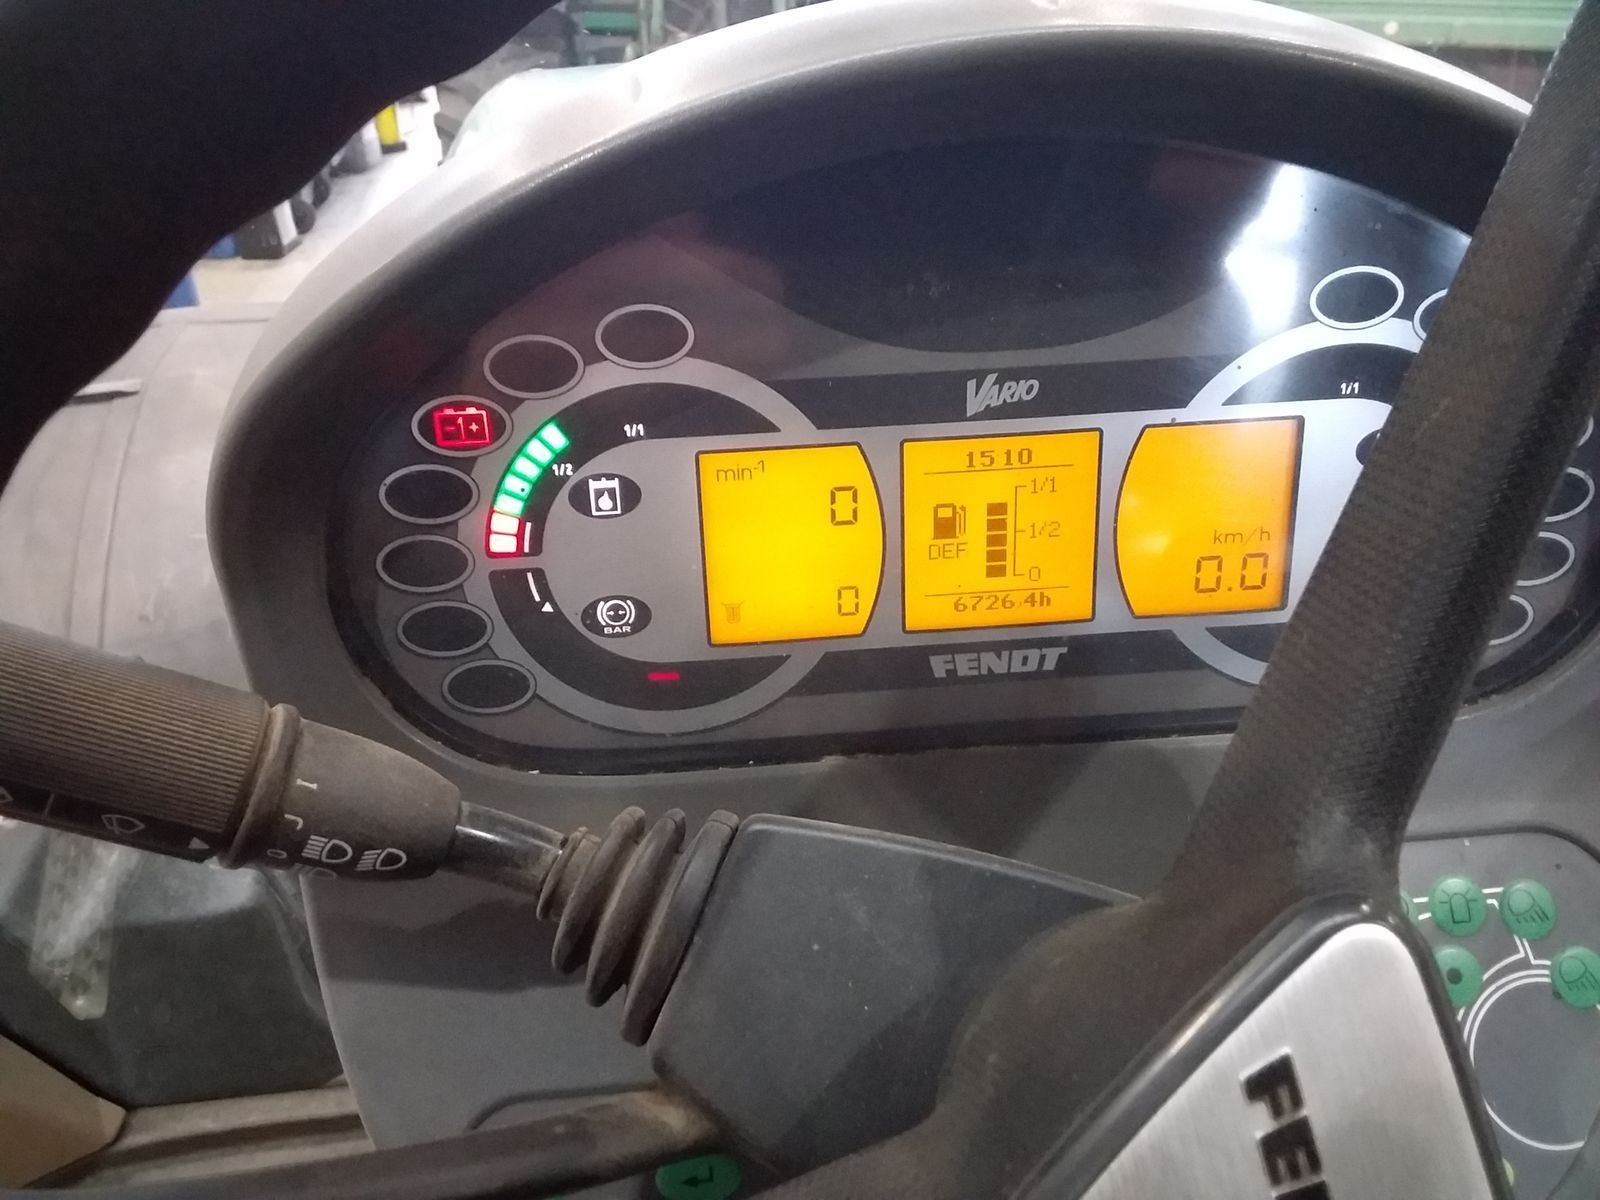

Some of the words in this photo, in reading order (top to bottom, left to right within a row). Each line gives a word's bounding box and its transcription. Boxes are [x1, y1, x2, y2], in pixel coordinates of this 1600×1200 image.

[967, 373, 1039, 417] VARIO
[1340, 381, 1360, 395] 1/1
[624, 424, 645, 437] 1/1
[552, 463, 574, 476] 1/2
[1029, 476, 1058, 495] 1/1
[830, 486, 859, 526] 0
[1028, 520, 1062, 539] 1/2
[1212, 527, 1271, 546] km/h
[928, 542, 968, 561] DEF
[1027, 566, 1041, 582] 0
[1194, 553, 1269, 594] 0.0
[837, 585, 860, 617] 0
[603, 625, 632, 635] BAR
[930, 646, 1068, 678] FENDT
